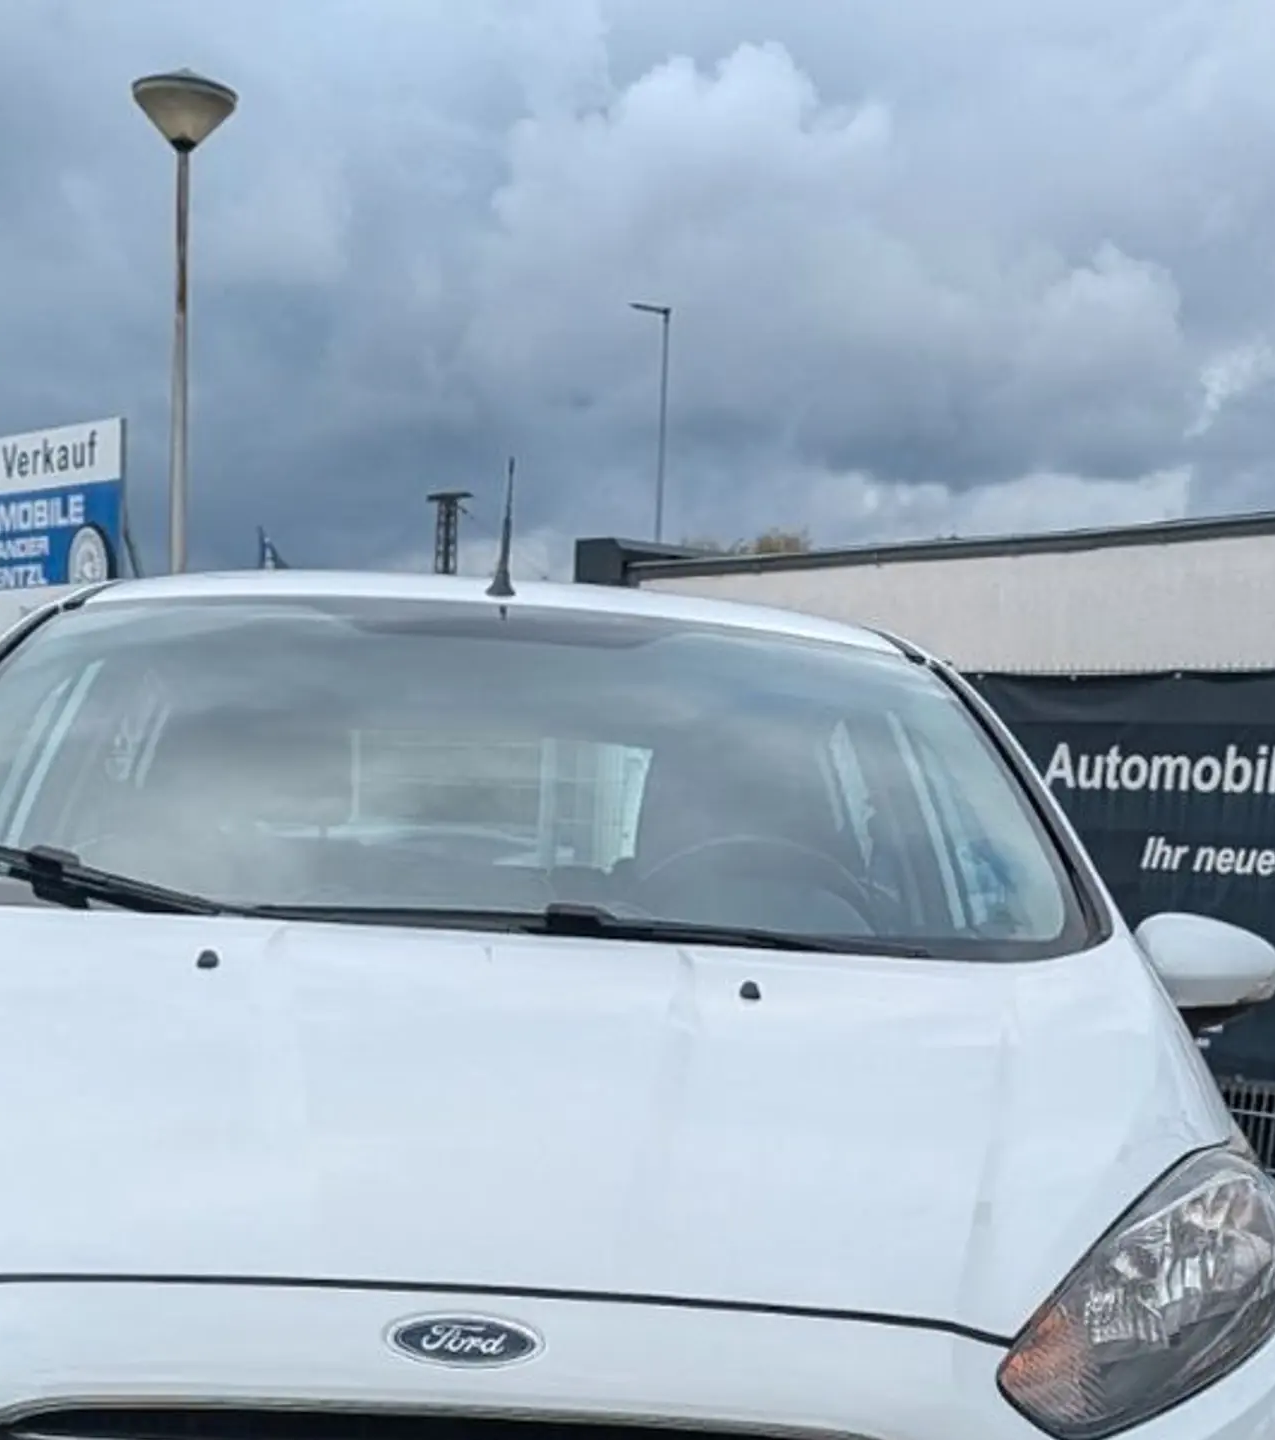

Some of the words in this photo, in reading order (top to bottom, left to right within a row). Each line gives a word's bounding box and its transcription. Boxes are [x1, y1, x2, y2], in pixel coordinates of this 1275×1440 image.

[2, 429, 98, 479] Verkauf
[1140, 836, 1189, 872] Ihr
[421, 1324, 508, 1354] Ford
